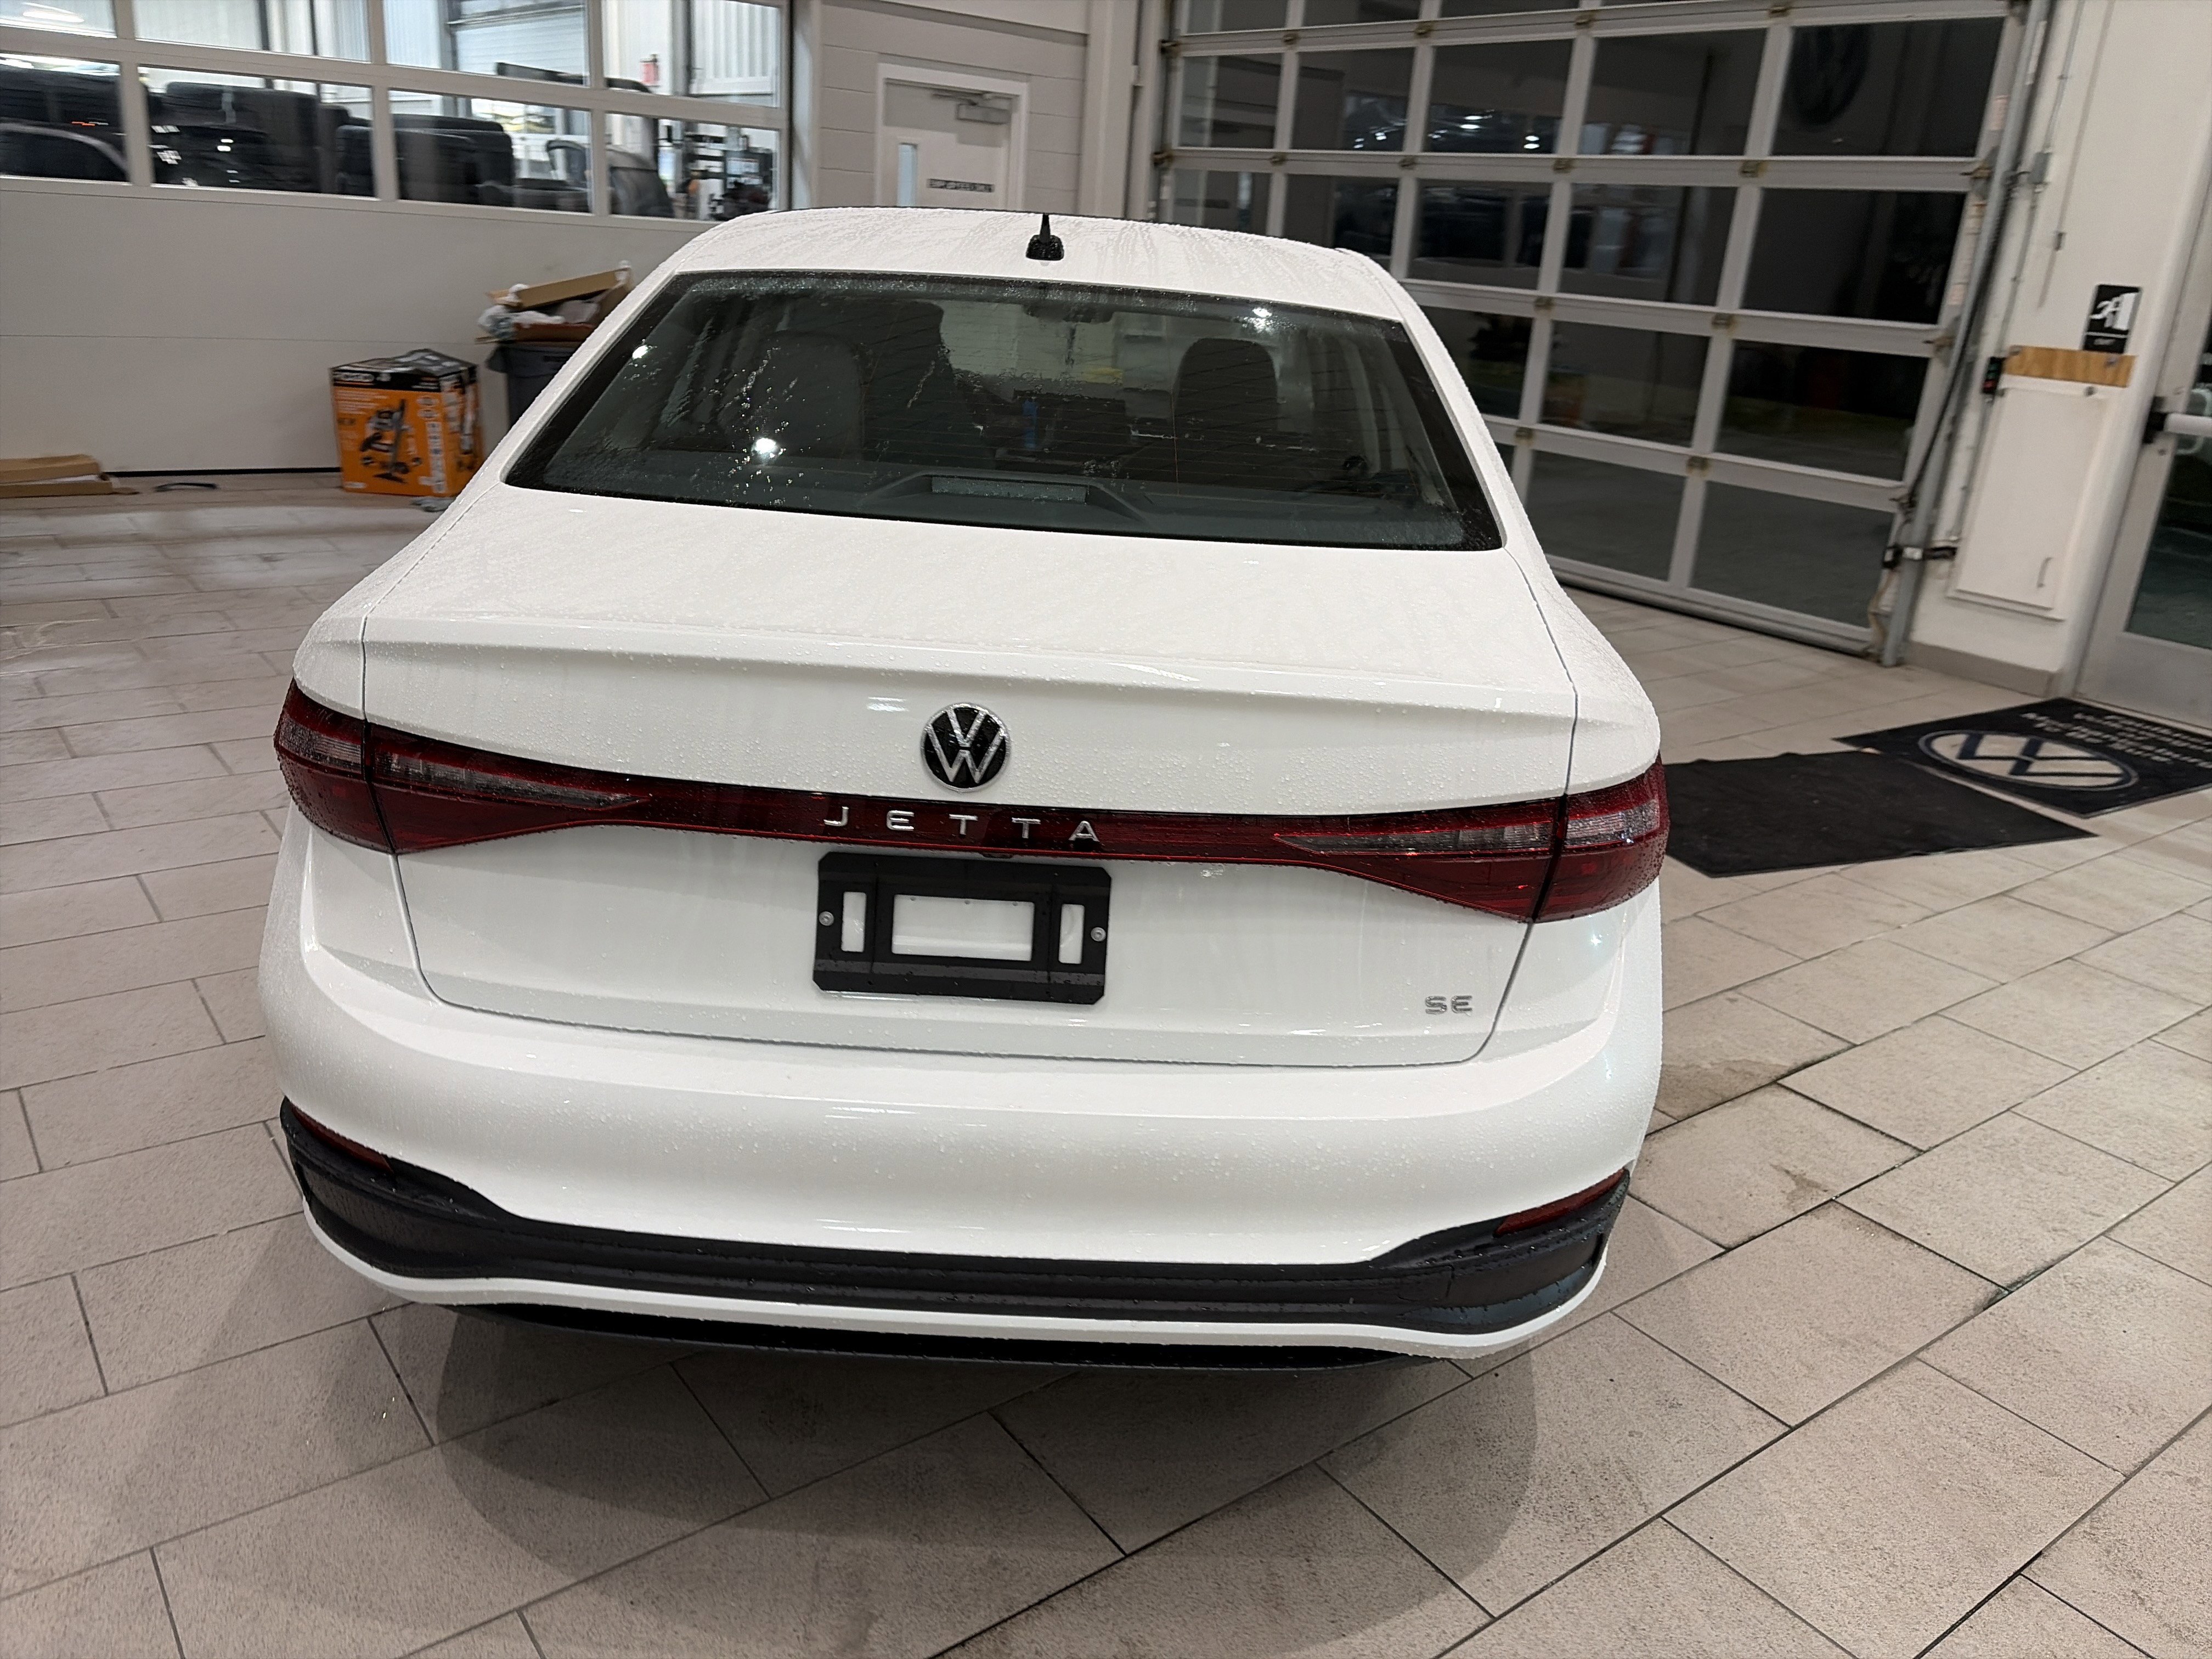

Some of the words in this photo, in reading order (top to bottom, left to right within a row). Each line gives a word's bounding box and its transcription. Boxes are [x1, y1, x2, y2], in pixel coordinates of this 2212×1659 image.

[923, 706, 1009, 786] VW
[823, 806, 1098, 842] JETTA
[1424, 995, 1472, 1015] SE
